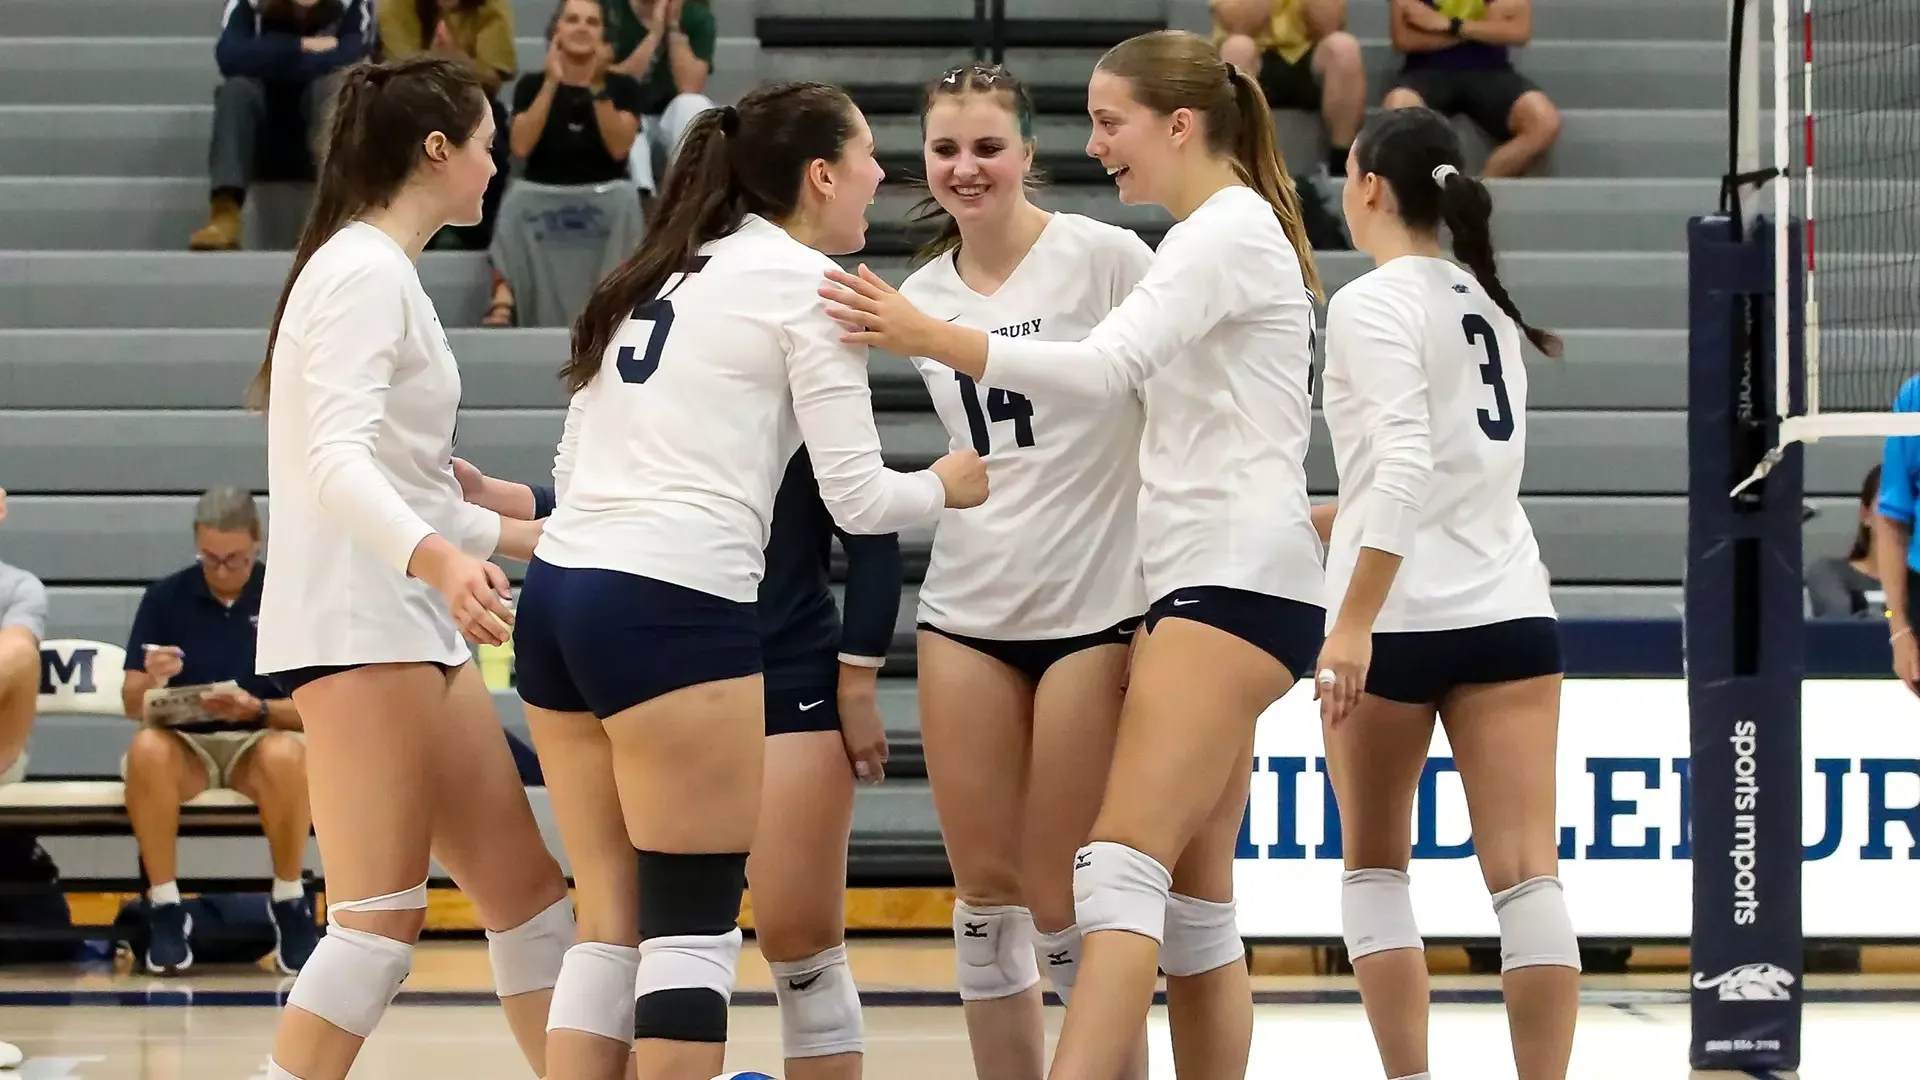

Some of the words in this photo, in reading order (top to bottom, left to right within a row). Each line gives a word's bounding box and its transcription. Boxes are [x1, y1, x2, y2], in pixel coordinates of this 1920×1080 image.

[616, 255, 713, 384] 5
[990, 318, 1042, 339] BURY
[954, 369, 1036, 458] 14
[1461, 313, 1515, 442] 3
[38, 649, 97, 694] M
[1730, 719, 1760, 810] sports
[1729, 814, 1760, 925] imports
